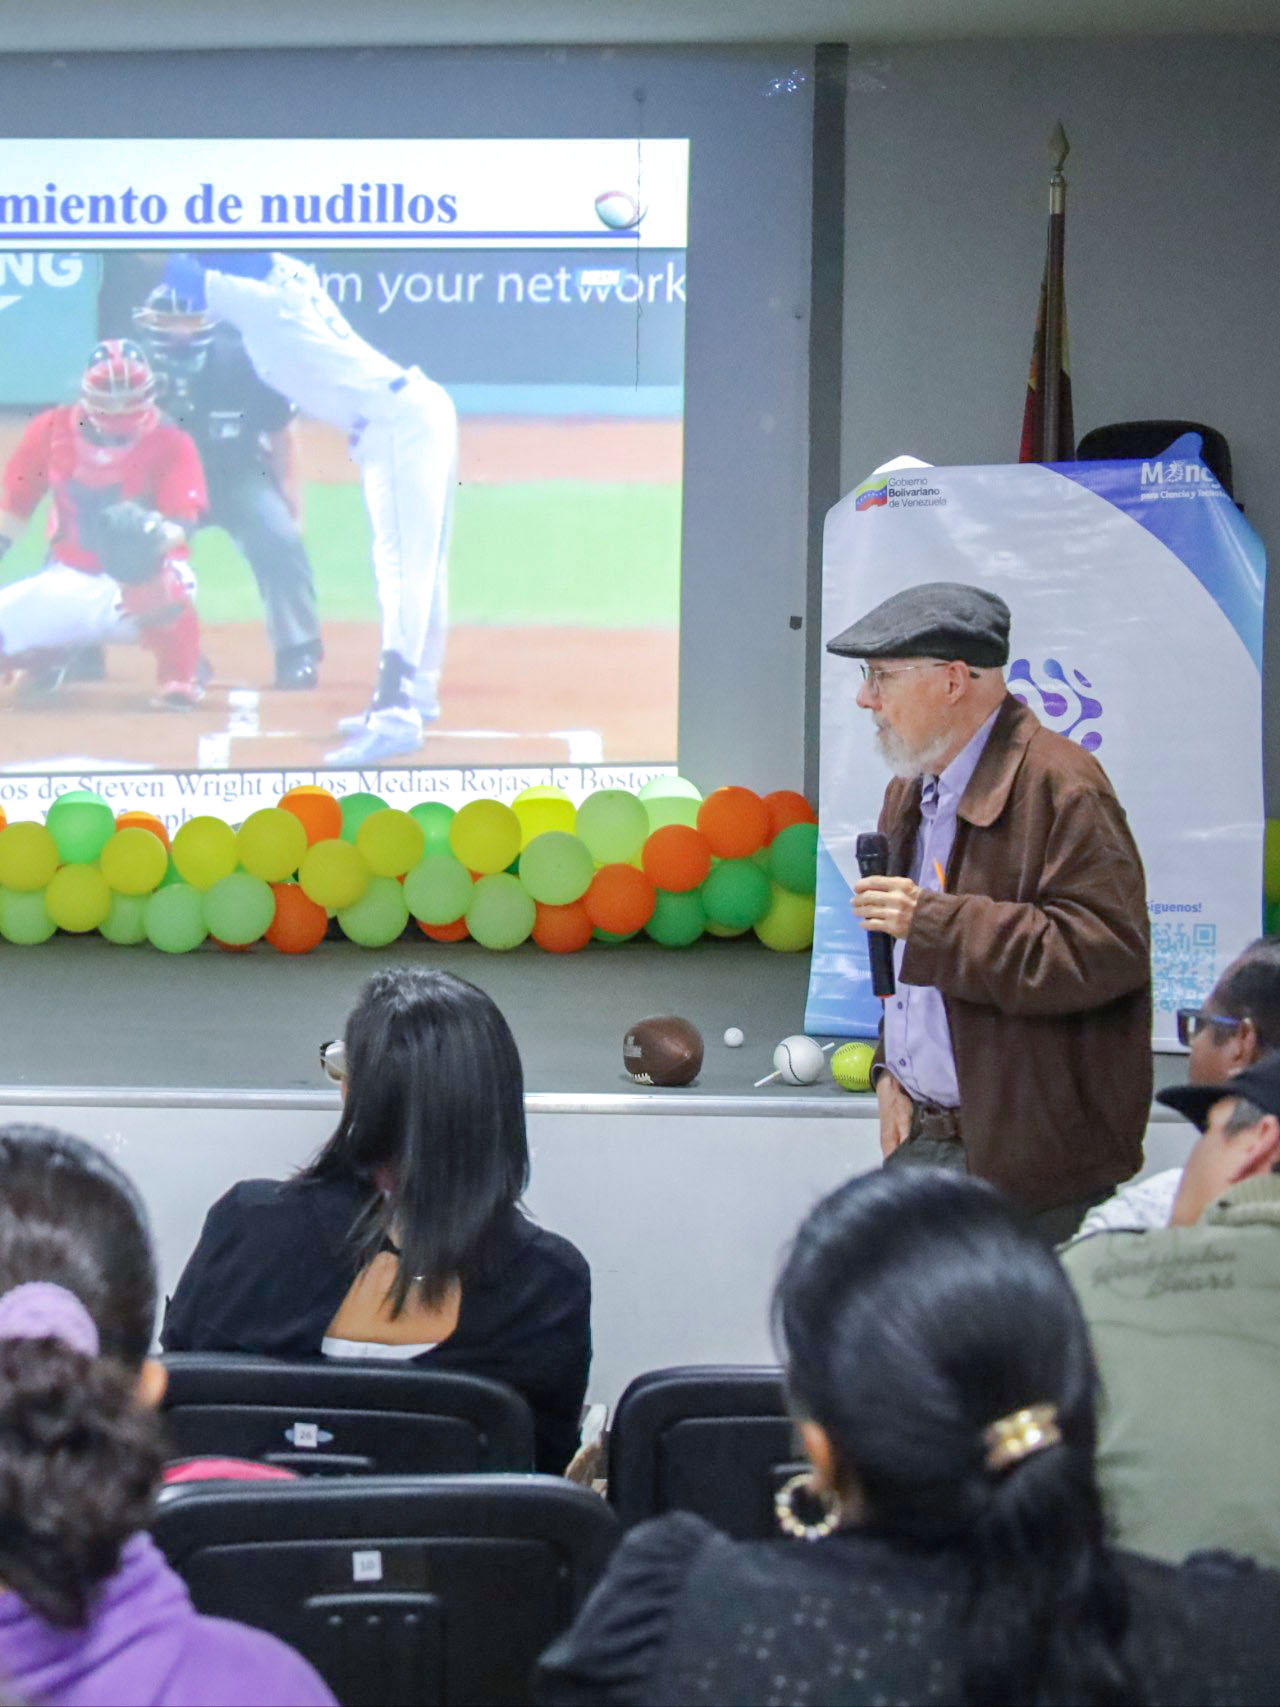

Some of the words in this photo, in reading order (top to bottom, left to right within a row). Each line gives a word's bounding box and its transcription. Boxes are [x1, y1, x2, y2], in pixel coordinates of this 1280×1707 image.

[184, 183, 243, 225] de
[260, 182, 458, 225] nudillos
[377, 272, 484, 314] your
[497, 263, 687, 304] network
[889, 478, 927, 486] Gobierno
[889, 488, 939, 497] Bolivariano
[889, 499, 899, 507] de
[902, 497, 946, 507] Venezuela
[38, 775, 68, 800] de
[77, 775, 165, 799] Steven
[175, 772, 263, 803] Wright
[313, 771, 347, 794] los
[359, 770, 450, 794] Medias
[461, 768, 532, 798] Rojas
[540, 767, 569, 791] de
